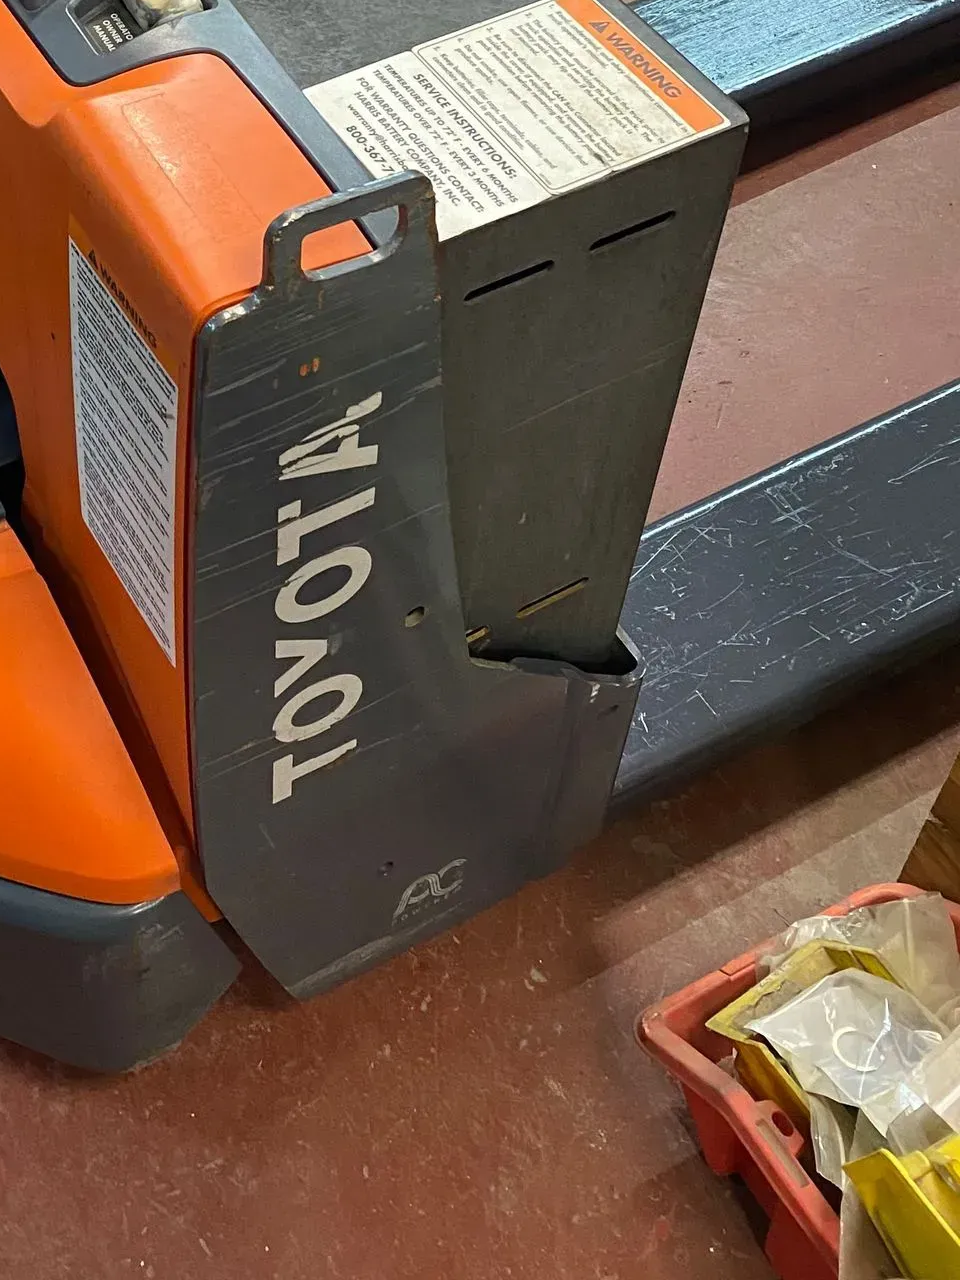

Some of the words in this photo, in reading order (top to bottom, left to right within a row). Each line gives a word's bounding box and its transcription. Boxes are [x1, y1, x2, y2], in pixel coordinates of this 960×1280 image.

[91, 24, 117, 53] MANUAL
[101, 19, 124, 45] OWNER
[109, 12, 135, 42] OPERATO
[516, 24, 536, 42] battery
[532, 42, 549, 54] pack
[547, 54, 560, 65] may
[559, 65, 568, 73] tip
[566, 73, 580, 83] over
[583, 88, 594, 97] the
[592, 96, 613, 115] battery
[610, 116, 627, 128] pack
[524, 22, 539, 35] truck
[537, 34, 562, 57] operation
[560, 57, 575, 67] and
[571, 67, 595, 88] servicing
[594, 88, 604, 97] the
[603, 96, 624, 115] battery
[621, 115, 638, 130] pack.
[640, 131, 652, 142] The
[532, 18, 543, 28] The
[541, 27, 561, 45] battery
[558, 45, 574, 57] pack
[572, 57, 587, 69] must
[592, 76, 616, 95] secured
[619, 101, 630, 110] the
[629, 110, 643, 123] truck
[641, 123, 658, 137] prior
[606, 32, 681, 97] WARNING
[346, 125, 394, 171] 800-367-7
[347, 104, 408, 171] warranty@harrisba
[354, 91, 381, 117] HARRIS
[377, 117, 409, 146] BATTERY
[406, 148, 444, 188] COMPANY,
[442, 188, 460, 206] INC.
[356, 77, 373, 92] FOR
[370, 91, 411, 130] WARRANTY
[408, 132, 449, 174] QUESTIONS
[447, 175, 483, 212] CONTACT:
[373, 69, 415, 112] TEMPERATURES
[413, 112, 431, 129] OVER
[448, 150, 471, 169] EVERY
[473, 177, 504, 206] MONTHS
[384, 64, 426, 106] TEMPERATURES
[424, 106, 436, 115] UP
[433, 116, 444, 125] TO
[462, 146, 484, 165] EVERY
[486, 173, 518, 202] MONTHS
[413, 73, 450, 107] SERVICE
[447, 108, 516, 178] INSTRUCTIONS:
[485, 36, 501, 50] inside
[500, 50, 510, 59] the
[509, 59, 524, 74] cover,
[528, 78, 555, 102] equipped,
[553, 103, 568, 113] and
[564, 113, 585, 133] remove
[584, 133, 595, 142] the
[593, 142, 615, 161] battery
[500, 40, 512, 51] sure
[517, 57, 544, 81] disconnect
[542, 81, 552, 90] the
[551, 90, 566, 101] CAN
[563, 101, 574, 111] Bus
[574, 111, 601, 136] Connector
[599, 136, 622, 156] located
[99, 263, 158, 349] WARNING
[272, 391, 382, 804] TOYOTA
